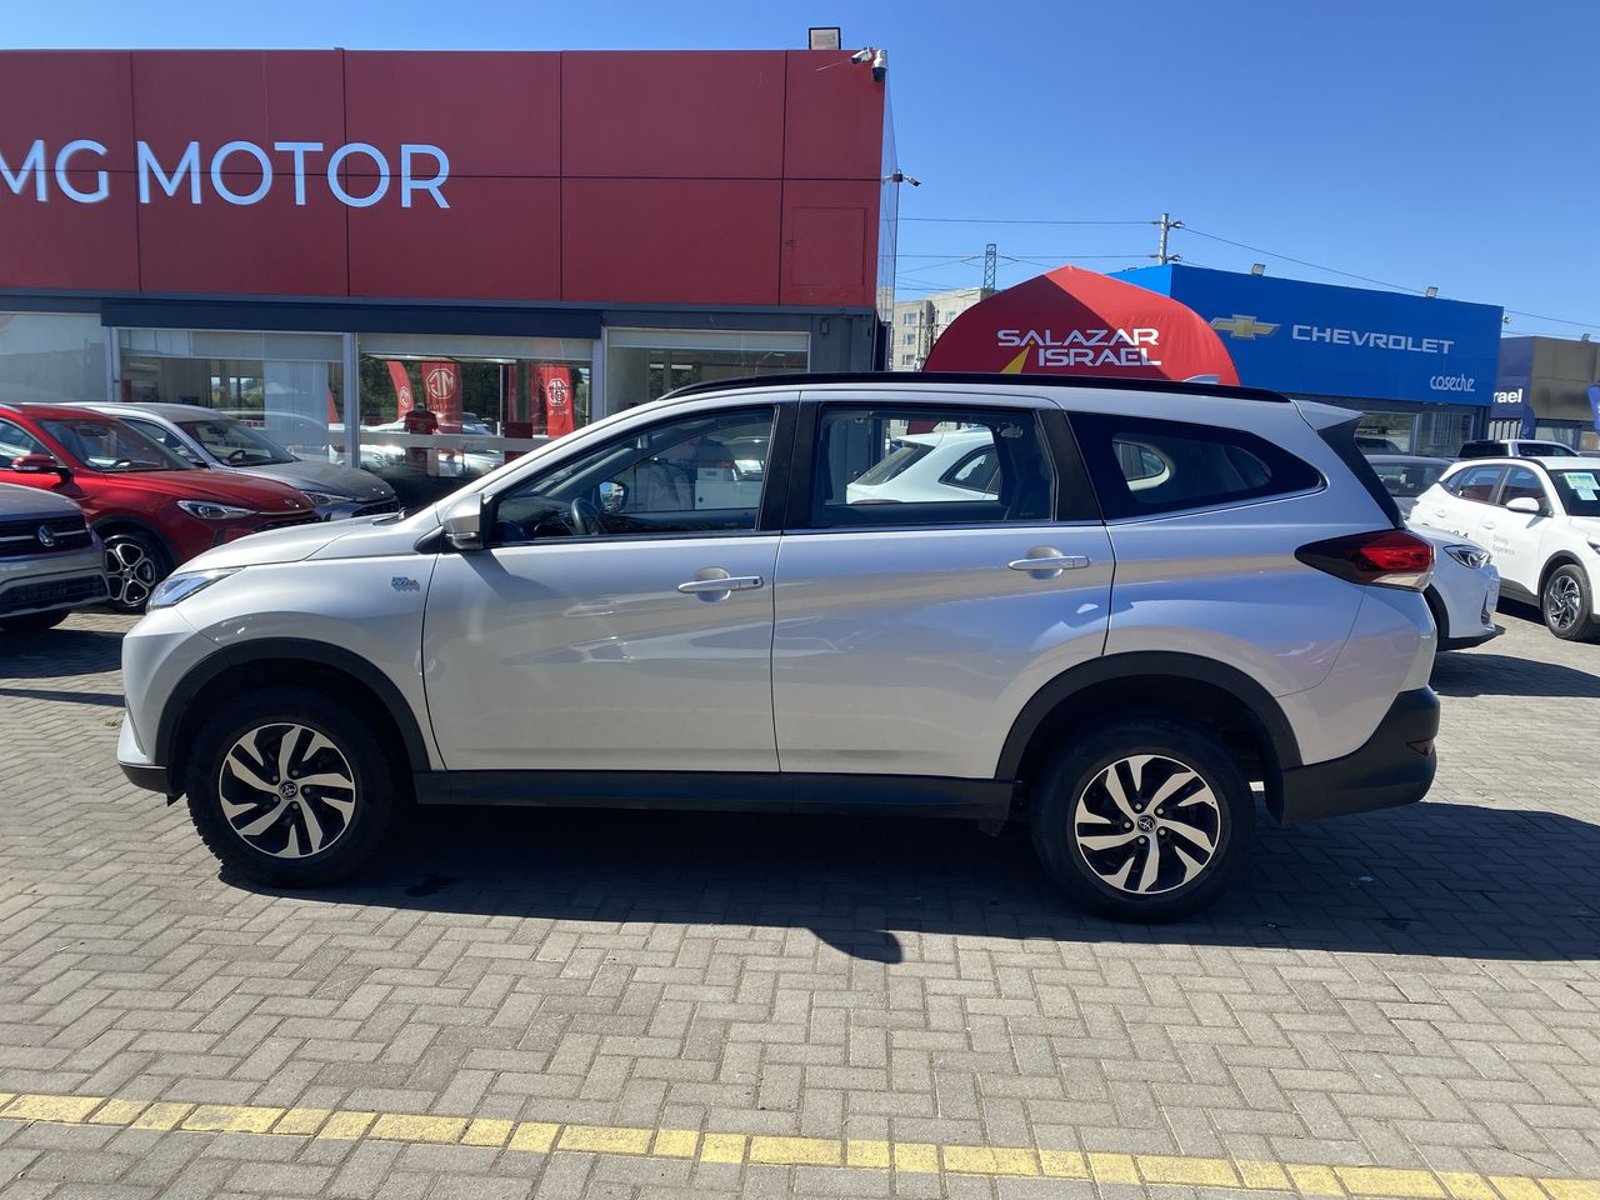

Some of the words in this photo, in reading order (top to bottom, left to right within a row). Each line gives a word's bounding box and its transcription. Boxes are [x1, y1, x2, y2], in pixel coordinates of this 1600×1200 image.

[0, 139, 110, 203] MG
[137, 141, 451, 208] MOTOR
[997, 328, 1160, 347] SALAZAR
[1292, 324, 1454, 354] CHEVROLET
[1038, 347, 1162, 367] ISRAEL
[1429, 373, 1476, 392] coseche
